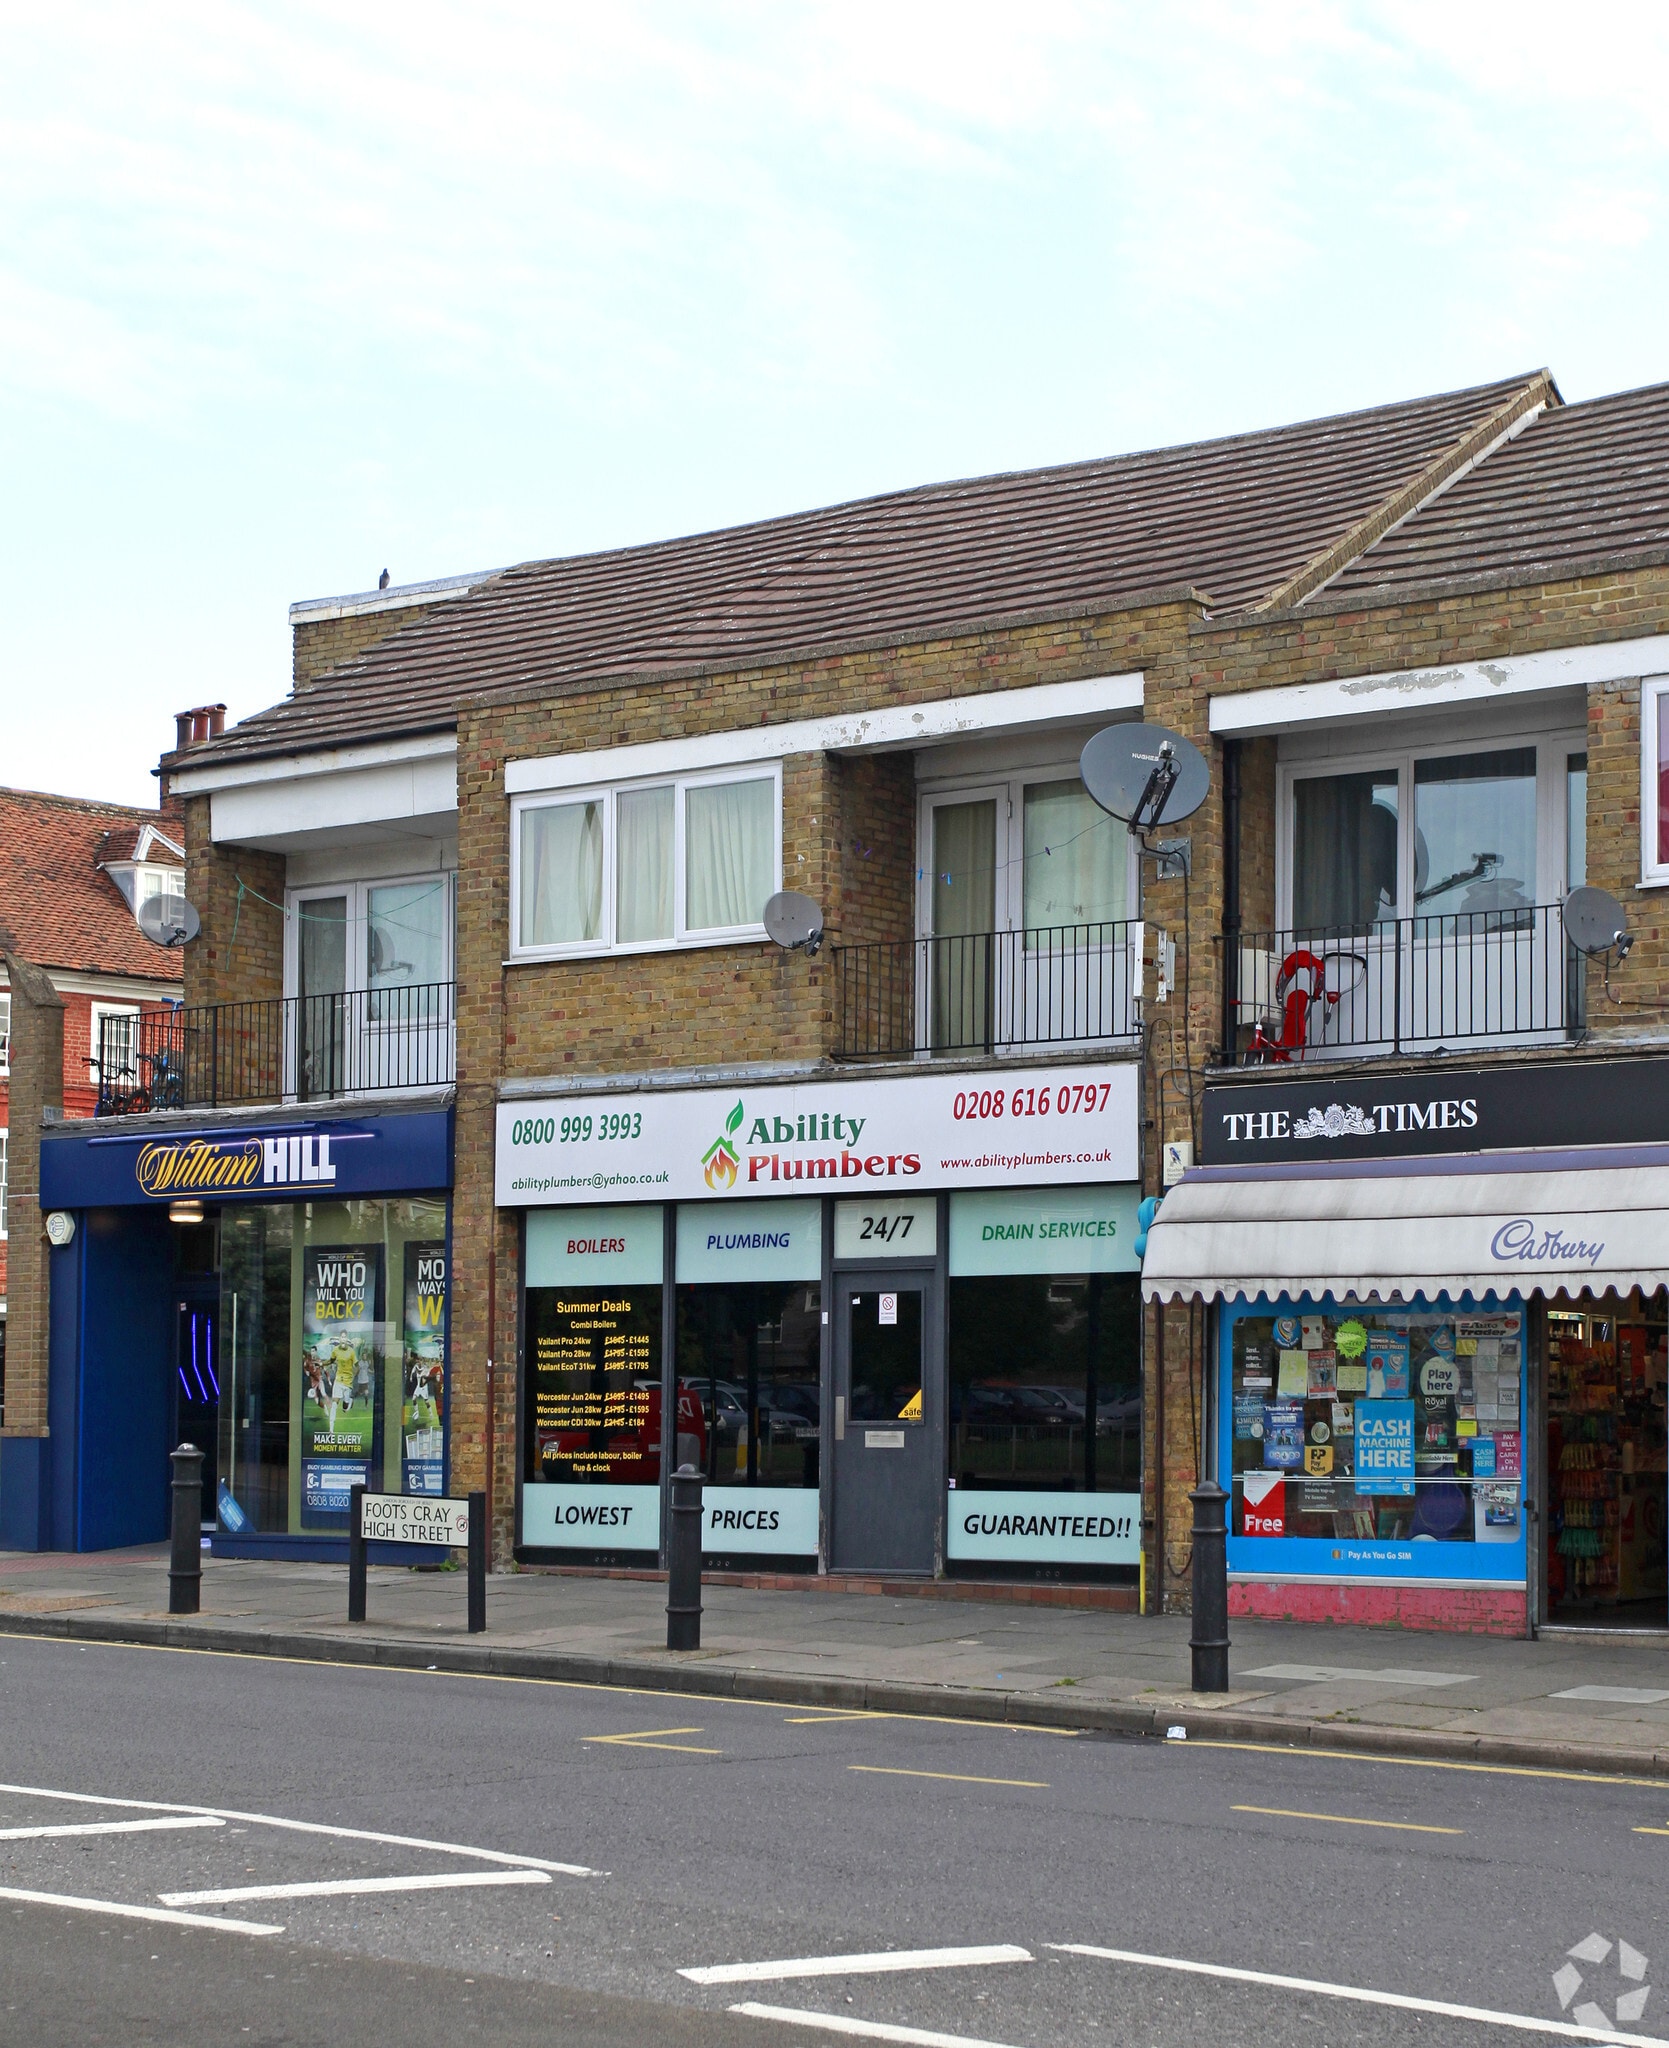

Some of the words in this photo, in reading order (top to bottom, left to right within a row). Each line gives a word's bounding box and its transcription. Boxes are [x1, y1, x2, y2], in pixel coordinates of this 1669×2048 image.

[953, 1089, 1005, 1120] 0208
[1011, 1087, 1050, 1117] 616
[1057, 1083, 1111, 1114] 0797
[1222, 1111, 1290, 1141] THE
[1372, 1099, 1478, 1133] TIMES
[511, 1117, 555, 1145] 0800
[559, 1115, 593, 1143] 999
[598, 1112, 642, 1141] 3993
[745, 1112, 867, 1148] Ability
[136, 1138, 263, 1191] William
[263, 1134, 337, 1184] HILL
[747, 1150, 921, 1182] Plumbers
[940, 1149, 1111, 1169] www.abilityplumbers.co.uk
[511, 1170, 669, 1192] abilityplumbers@yahoo.co.uk
[859, 1215, 914, 1243] 24/7
[982, 1223, 1034, 1241] DRAIN
[1038, 1220, 1117, 1239] SERVICES
[566, 1238, 625, 1254] BOILERS
[707, 1232, 791, 1250] PLUMBING
[1490, 1218, 1605, 1267] Cadbury
[317, 1262, 366, 1288] WHO
[316, 1288, 341, 1301] WILL
[344, 1287, 365, 1300] YOU
[315, 1301, 364, 1320] BACK?
[556, 1301, 600, 1313] Summer
[602, 1300, 631, 1312] Deals
[570, 1321, 593, 1329] Combi
[593, 1320, 617, 1328] Boilers
[1460, 1328, 1507, 1336] Trader
[561, 1337, 573, 1345] Pro
[574, 1336, 591, 1345] 24kw
[629, 1336, 649, 1344] £1445
[561, 1350, 573, 1358] Pro
[574, 1349, 591, 1358] 28kw
[629, 1349, 649, 1357] £1595
[561, 1363, 578, 1371] EcoT
[579, 1362, 596, 1370] 31kw
[629, 1362, 649, 1370] £1795
[1428, 1369, 1452, 1381] Play
[1427, 1380, 1453, 1391] here
[537, 1393, 570, 1401] Worcester
[571, 1393, 584, 1401] Jun
[629, 1393, 649, 1401] £1495
[1424, 1397, 1447, 1406] Royal
[537, 1406, 570, 1414] Worcester
[571, 1405, 584, 1414] Jun
[629, 1406, 649, 1414] £1595
[904, 1408, 922, 1417] safe
[537, 1419, 570, 1427] Worcester
[1359, 1419, 1411, 1436] CASH
[313, 1434, 335, 1444] MAKE
[337, 1434, 362, 1445] EVERY
[1359, 1438, 1411, 1448] MACHINE
[313, 1444, 337, 1452] MOMENT
[542, 1452, 551, 1460] All
[552, 1452, 573, 1461] prices
[573, 1451, 598, 1459] include
[598, 1451, 622, 1461] labour,
[622, 1452, 642, 1460] boiler
[1359, 1449, 1411, 1468] HERE
[572, 1464, 586, 1472] flue
[586, 1464, 592, 1472] &
[592, 1464, 611, 1472] clock
[307, 1494, 328, 1506] 0808
[329, 1495, 349, 1507] 8020
[365, 1502, 407, 1520] FOOTS
[413, 1505, 451, 1523] CRAY
[555, 1505, 633, 1526] LOWEST
[711, 1510, 779, 1530] PRICES
[963, 1514, 1131, 1539] GUARANTEED!!
[1244, 1514, 1283, 1532] Free
[363, 1521, 395, 1538] HIGH
[401, 1523, 453, 1542] STREET
[1348, 1551, 1361, 1560] Pay
[1397, 1552, 1412, 1560] SIM
